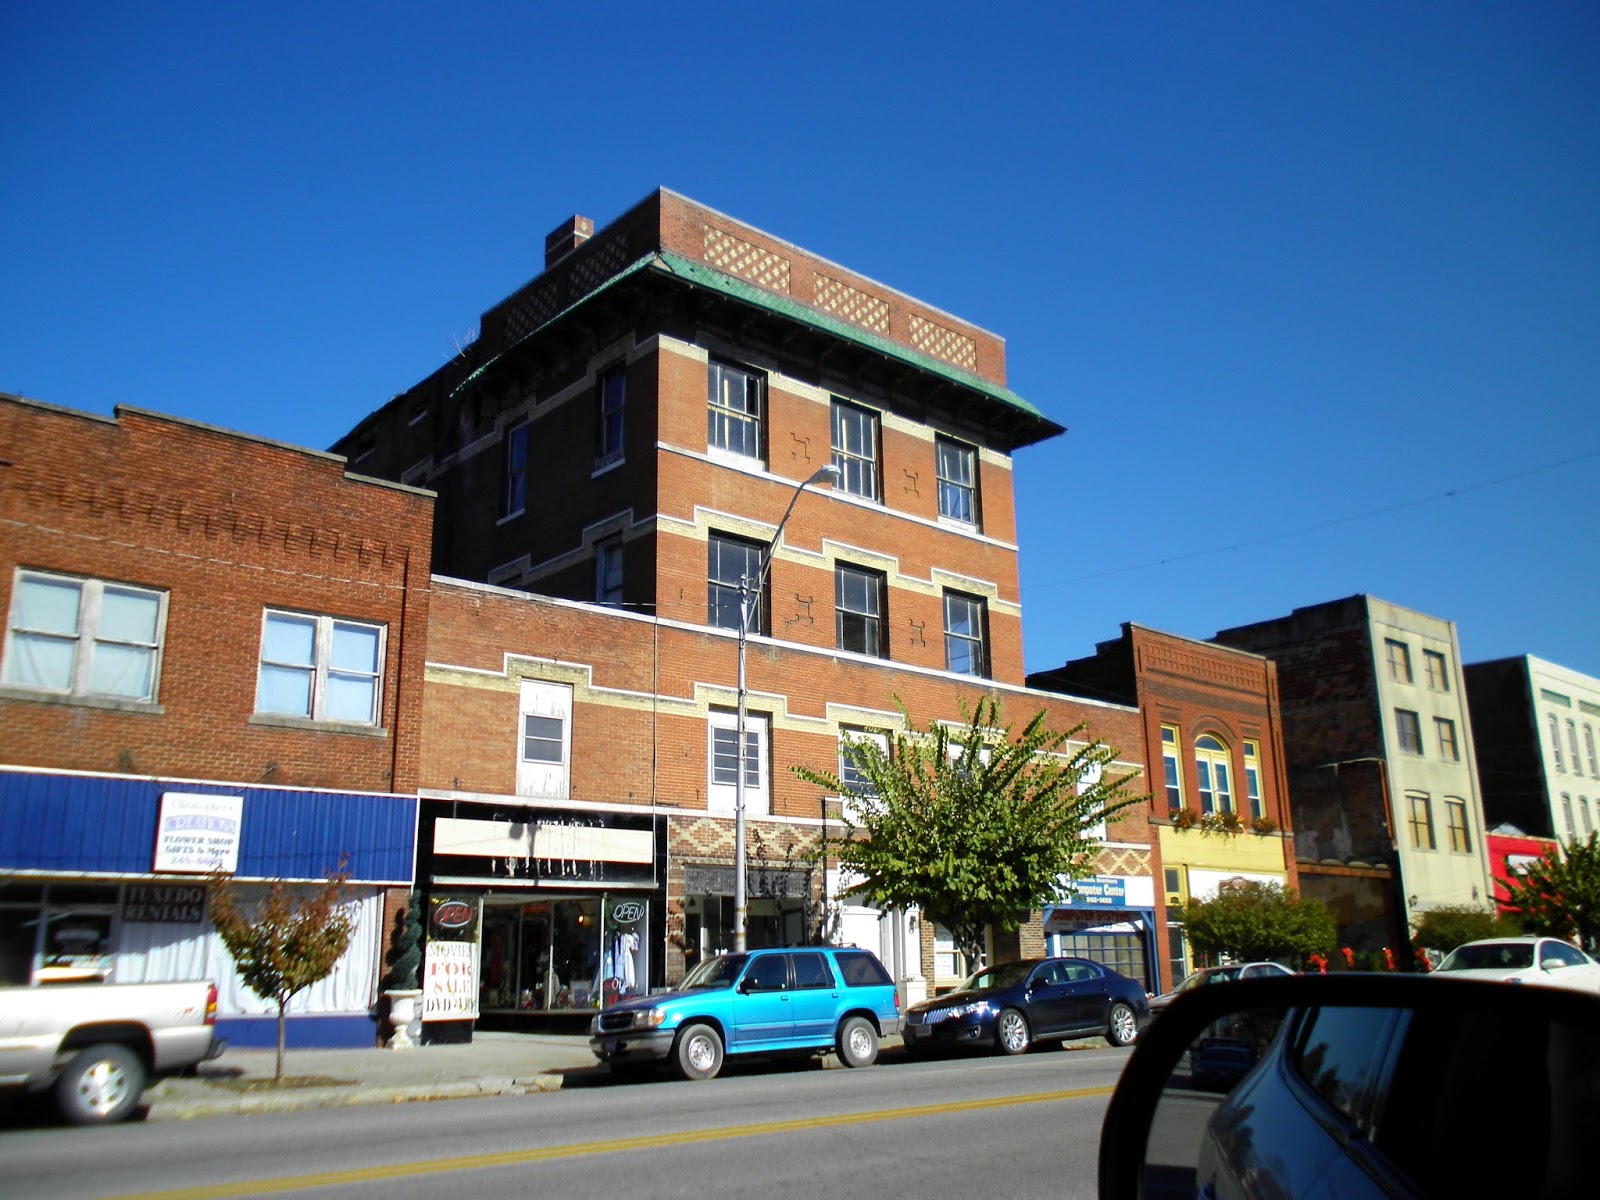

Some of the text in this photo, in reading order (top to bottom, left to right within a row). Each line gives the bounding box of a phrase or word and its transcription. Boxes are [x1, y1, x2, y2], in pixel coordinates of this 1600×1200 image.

[163, 835, 234, 846] FLOWER SHOP
[165, 845, 194, 854] GIFTS
[128, 887, 203, 903] TUXEDO
[1071, 882, 1125, 897] Computer Center
[125, 904, 201, 920] RENTALS
[434, 905, 472, 924] OPEN
[614, 904, 642, 921] OPEN
[1053, 909, 1130, 922] COMPUTER SYSTEMS
[428, 943, 472, 958] MOVIES
[429, 962, 472, 976] FOR
[432, 979, 470, 995] SALE
